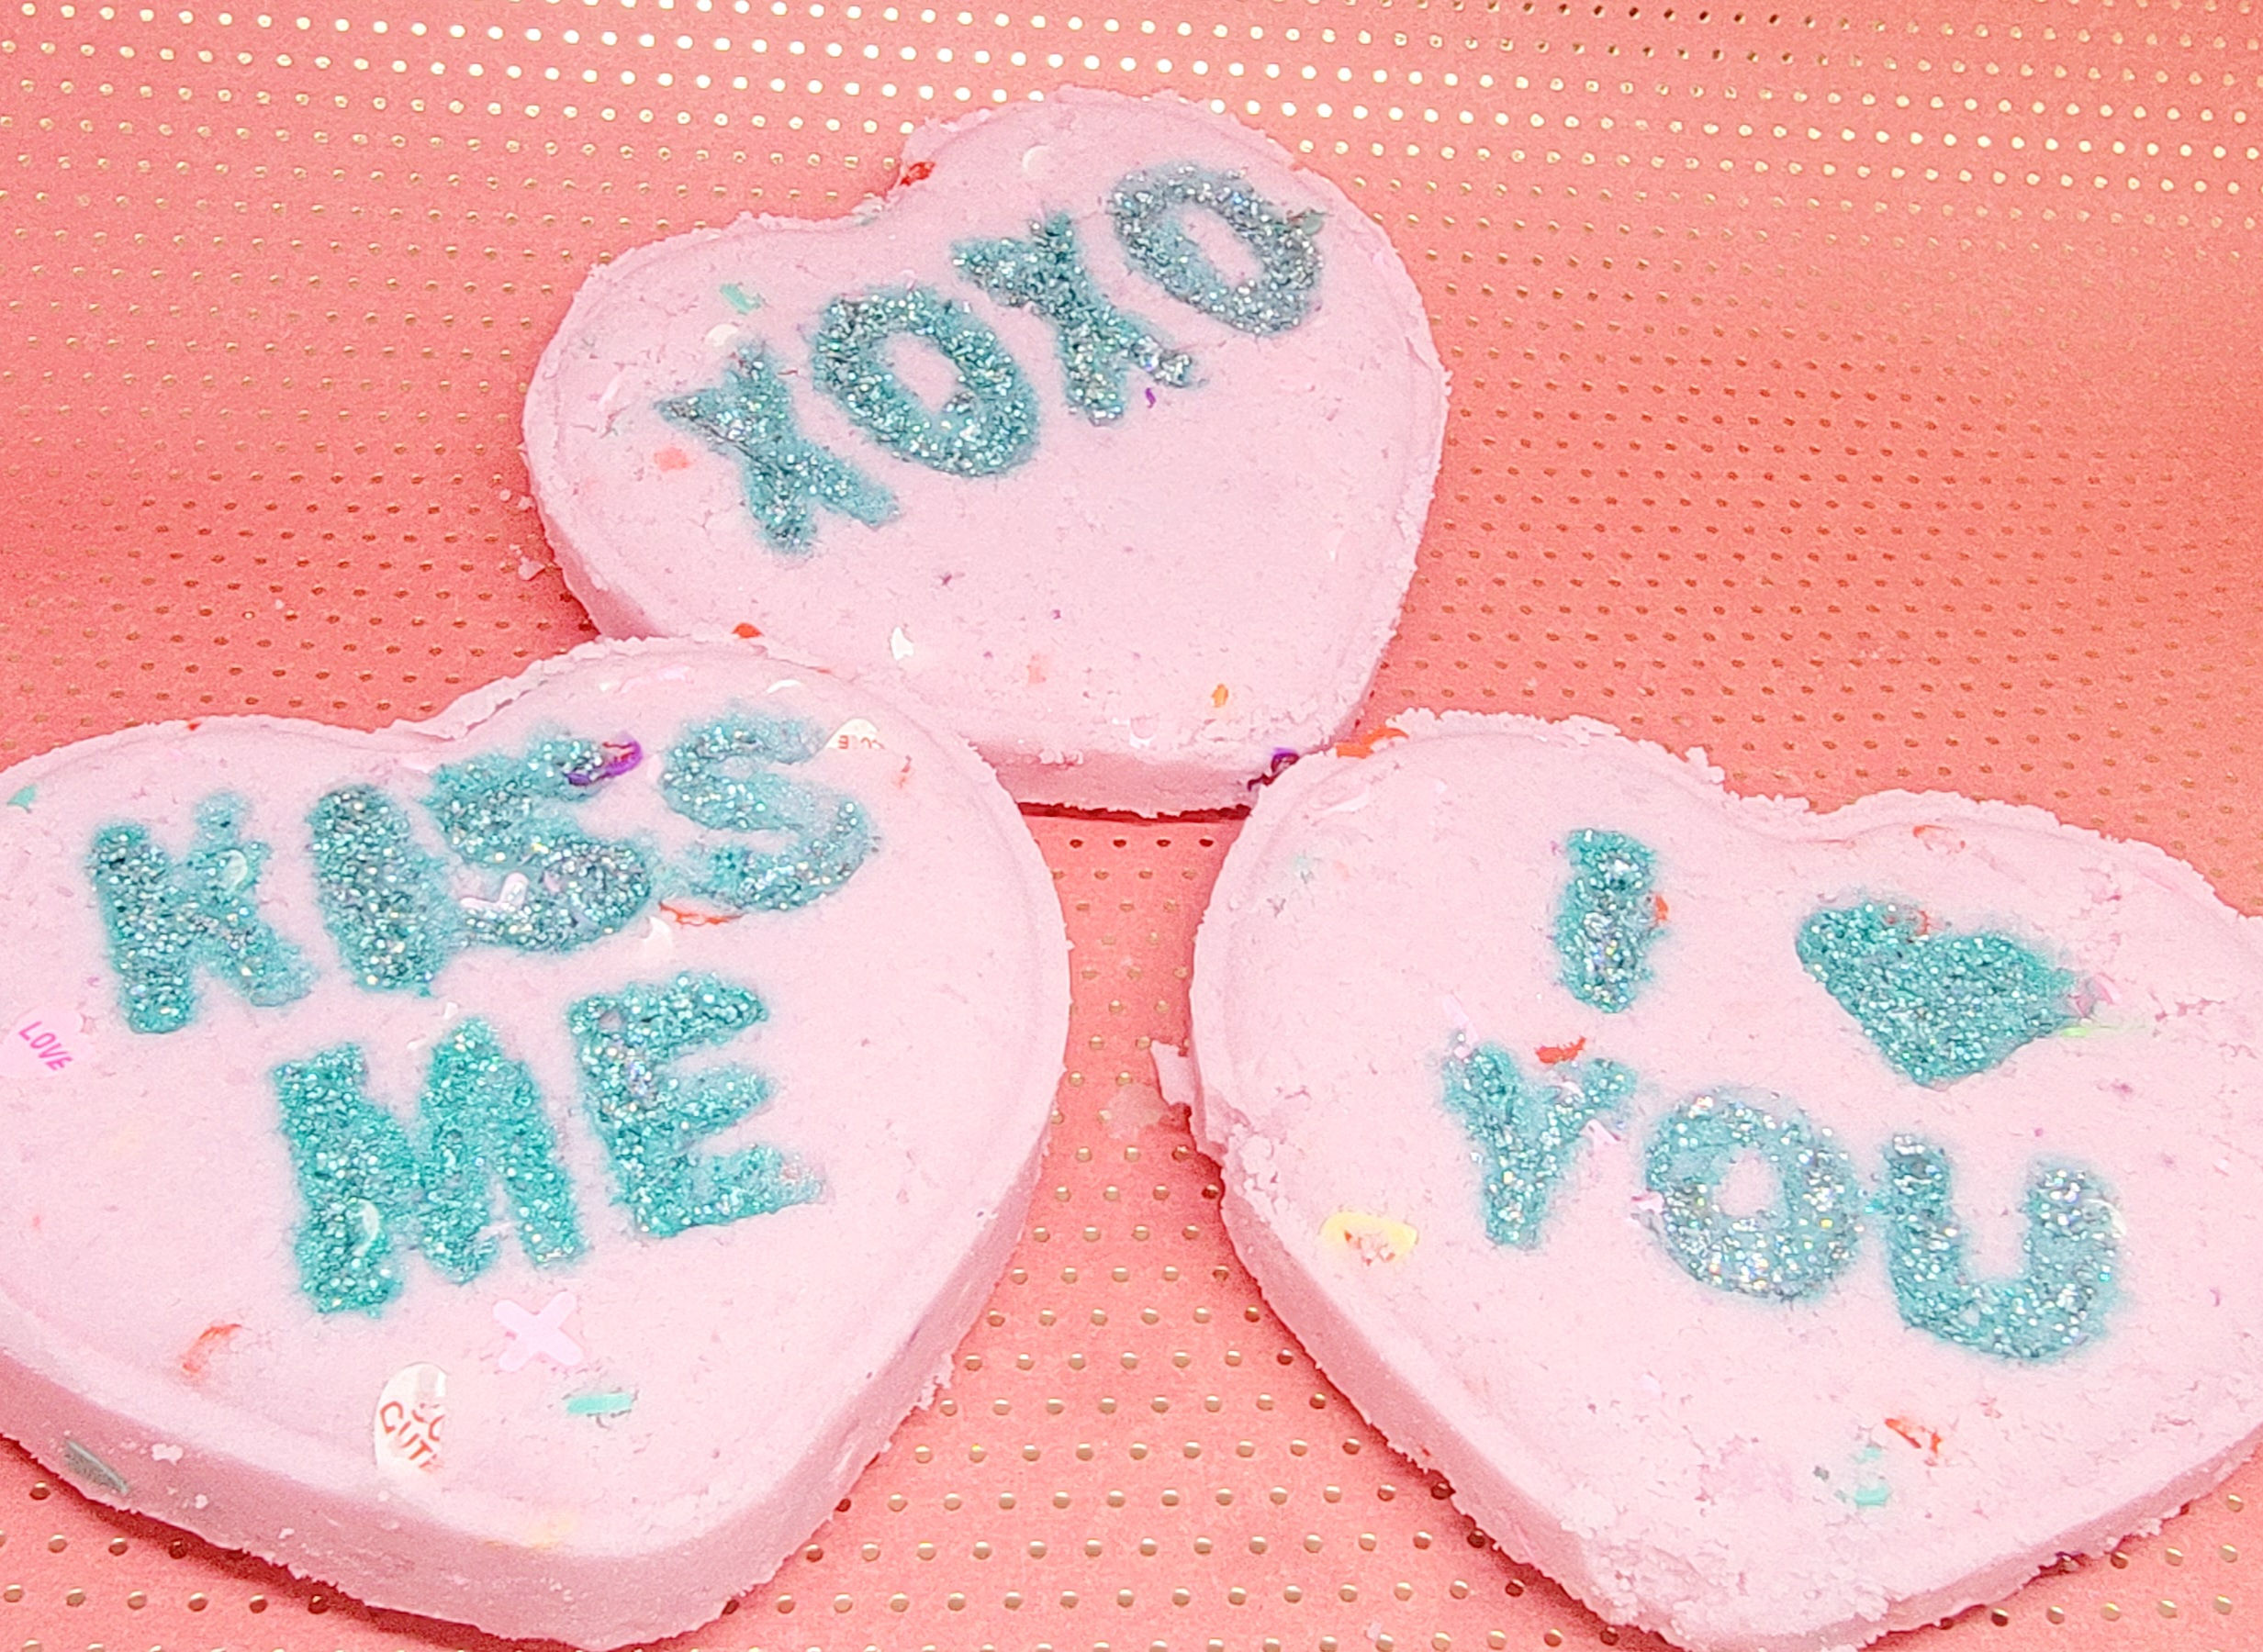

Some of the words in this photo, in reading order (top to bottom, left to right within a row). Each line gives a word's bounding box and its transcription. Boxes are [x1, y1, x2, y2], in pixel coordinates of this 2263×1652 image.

[652, 161, 1326, 559] XOXO
[87, 702, 879, 1035] KISS
[1552, 827, 1664, 1015] I
[18, 1021, 73, 1072] LOVE
[273, 970, 824, 1317] ME
[1440, 1039, 2123, 1364] YOU
